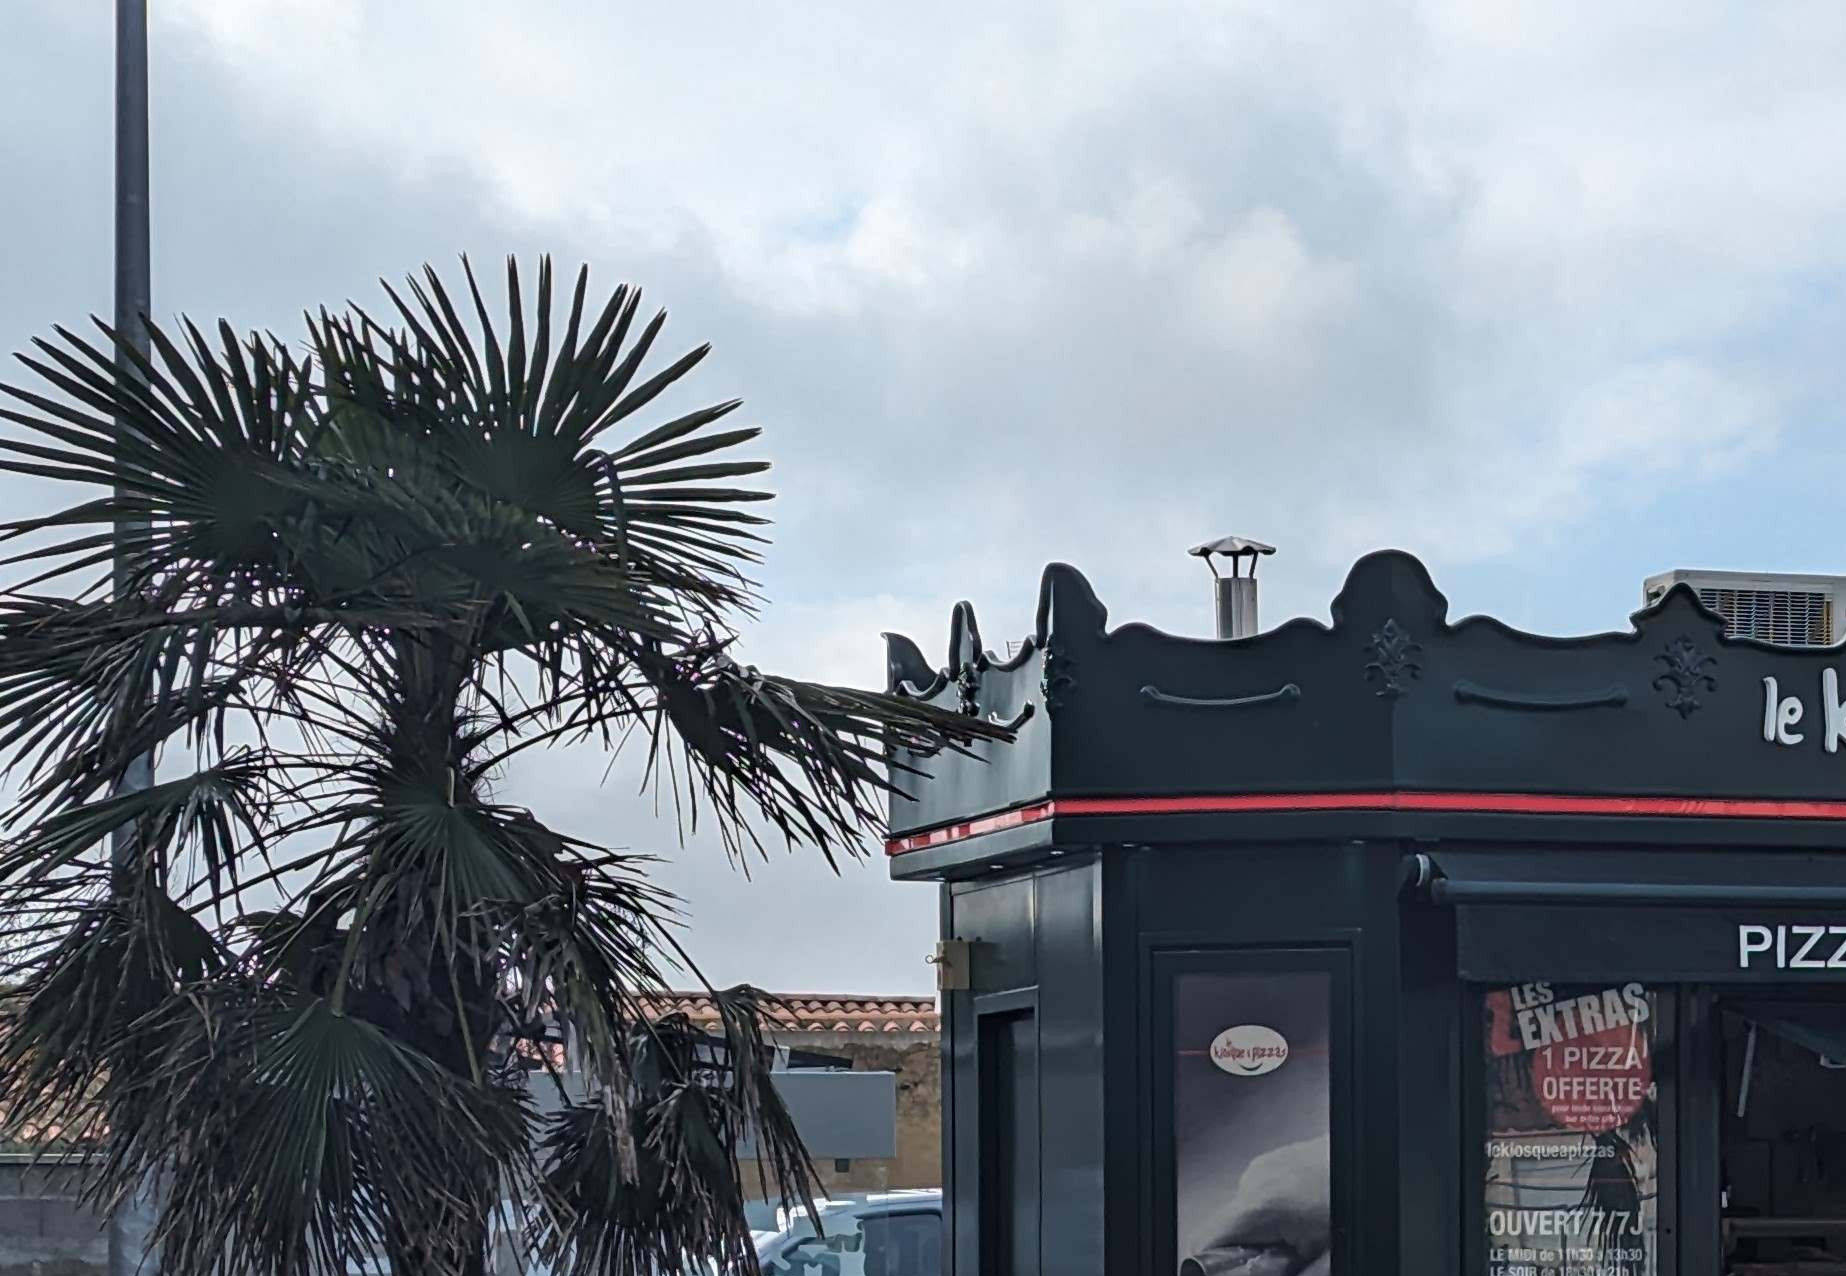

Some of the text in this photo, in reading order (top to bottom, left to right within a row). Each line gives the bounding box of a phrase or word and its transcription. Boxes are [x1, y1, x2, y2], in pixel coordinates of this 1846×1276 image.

[1763, 676, 1804, 746] le
[1511, 981, 1555, 1011] LES
[1517, 982, 1650, 1050] EXTRAS
[1542, 1046, 1643, 1071] 1 PIZZA
[1543, 1077, 1643, 1100] OFFERTE
[1490, 1210, 1583, 1236] OUVERT
[1490, 1249, 1504, 1262] LE
